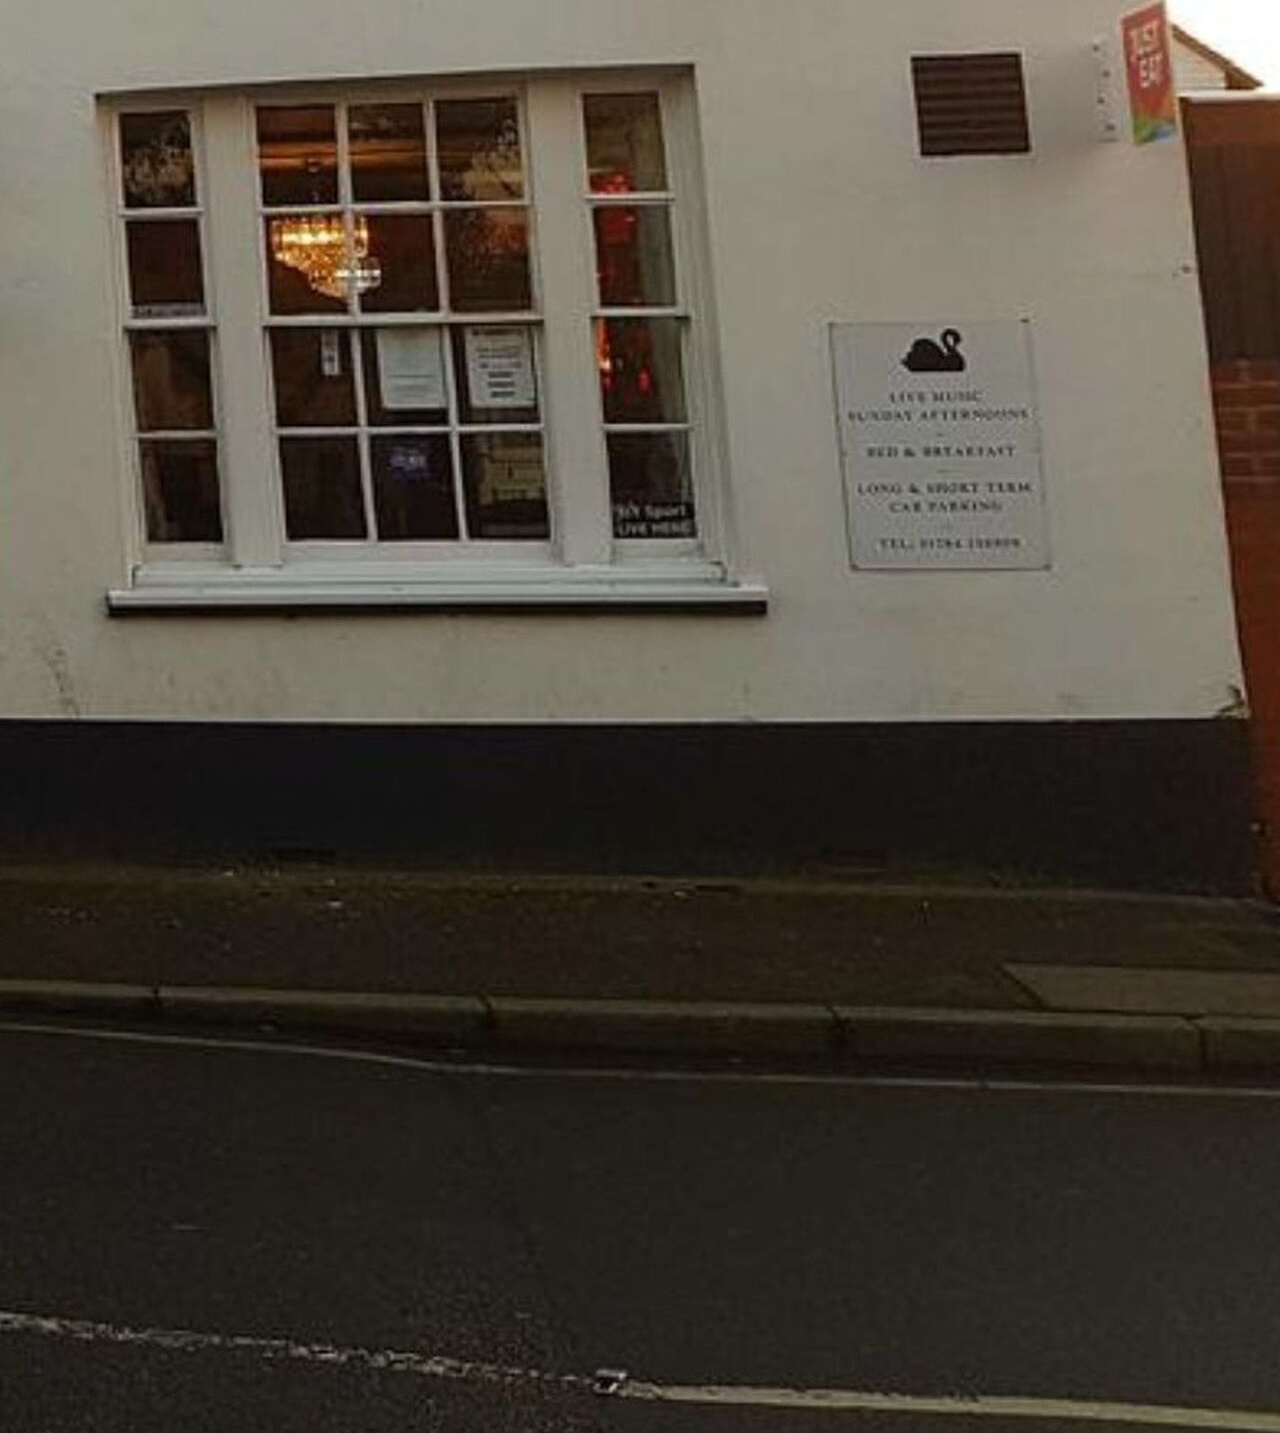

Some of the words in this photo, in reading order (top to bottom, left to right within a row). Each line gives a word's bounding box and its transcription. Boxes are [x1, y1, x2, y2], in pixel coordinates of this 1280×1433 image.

[866, 446, 899, 458] BED
[904, 447, 916, 457] &
[923, 445, 1017, 458] BREAKFAST
[857, 483, 902, 495] LONG
[909, 483, 920, 495] &
[926, 482, 979, 495] SHORT
